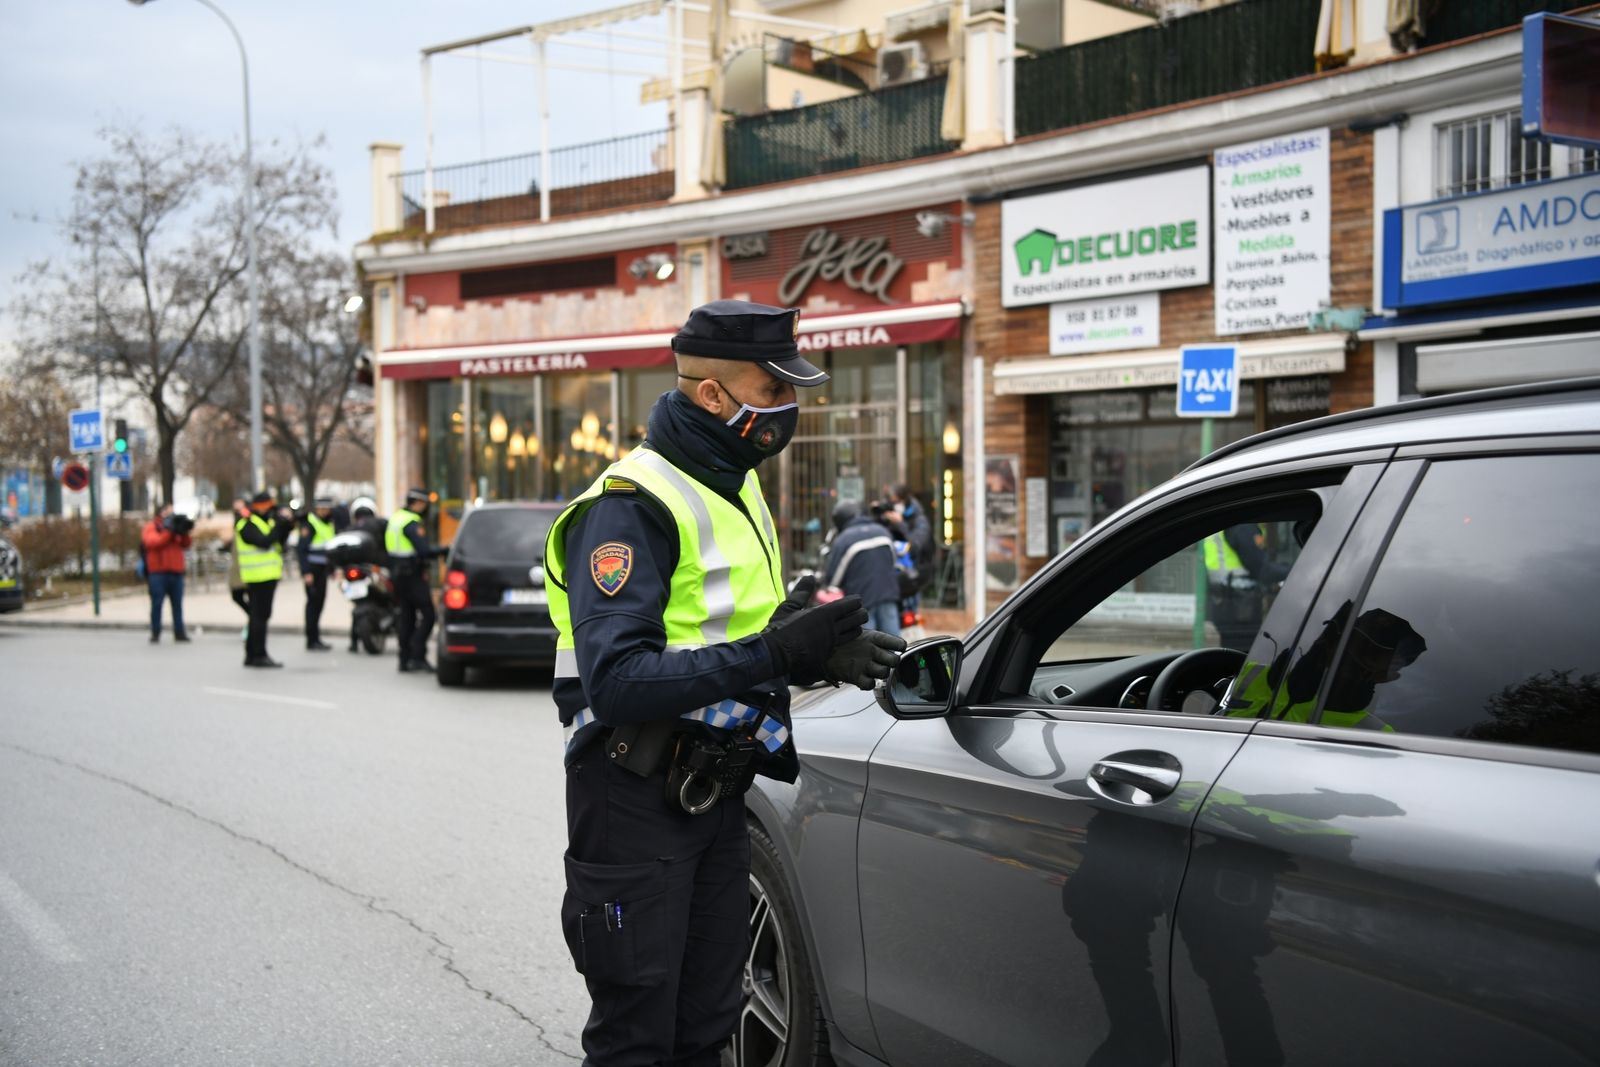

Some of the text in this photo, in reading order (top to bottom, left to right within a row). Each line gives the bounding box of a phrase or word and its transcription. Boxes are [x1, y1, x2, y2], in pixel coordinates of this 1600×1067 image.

[1231, 163, 1303, 187] Armarios
[1231, 185, 1314, 209] Vestidores
[1301, 209, 1311, 224] a
[722, 235, 769, 260] CASA
[1055, 220, 1197, 267] DECUORE
[1238, 235, 1295, 253] Medida
[1476, 239, 1564, 263] Diagnóstico
[1569, 237, 1579, 252] y
[1013, 265, 1197, 297] Especialistas en armarios
[797, 324, 892, 351] ADERÍA
[460, 352, 588, 375] PASTELERÍA
[1182, 367, 1234, 393] TAXI
